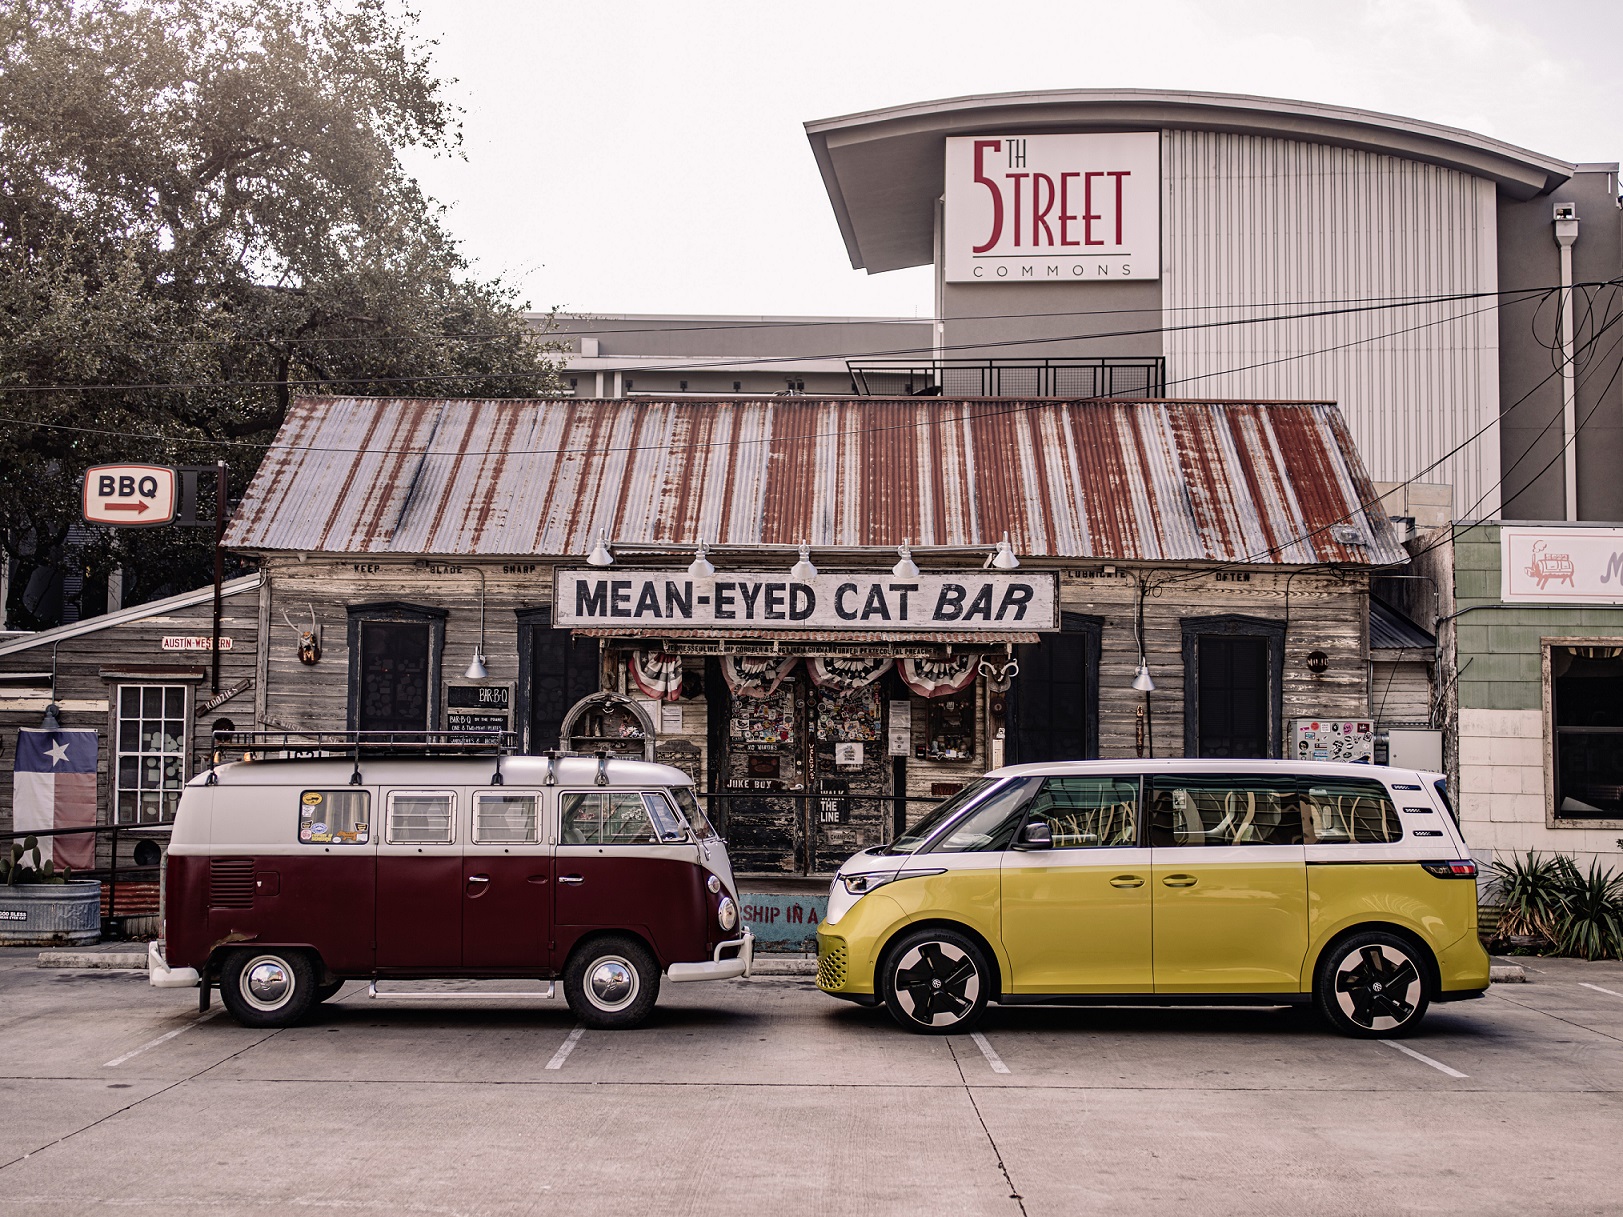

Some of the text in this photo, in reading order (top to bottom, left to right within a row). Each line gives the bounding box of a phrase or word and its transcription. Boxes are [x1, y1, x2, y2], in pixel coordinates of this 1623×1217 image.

[973, 264, 1131, 278] COMMONS
[99, 475, 158, 499] BBQ
[354, 565, 380, 573] KEEP
[503, 564, 536, 574] SHARP
[1215, 572, 1251, 582] OFTEN
[576, 579, 1035, 622] MEAN-EYED CAT BAR
[164, 637, 231, 649] AUSTIN-WESRN
[205, 687, 238, 710] KOOZIES
[820, 801, 837, 812] THE
[820, 811, 839, 823] LINE
[786, 905, 803, 924] IN
[807, 907, 819, 924] A
